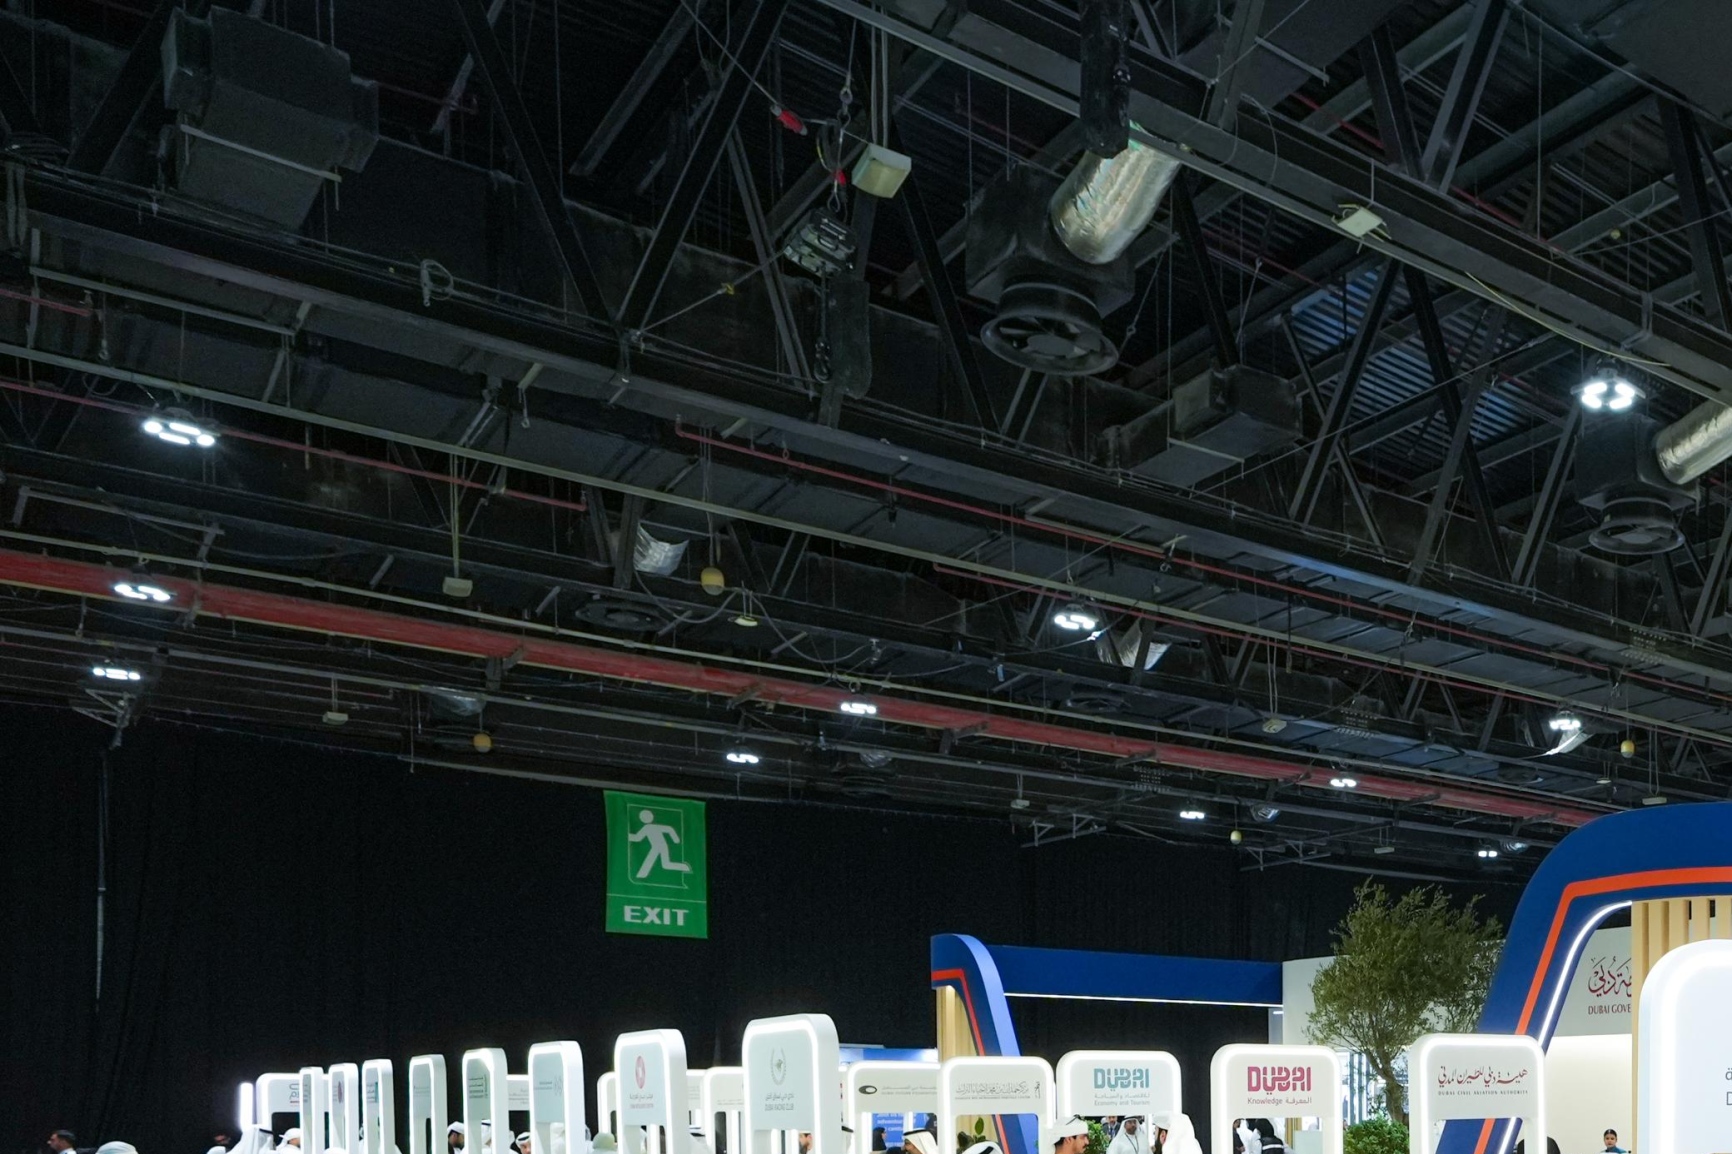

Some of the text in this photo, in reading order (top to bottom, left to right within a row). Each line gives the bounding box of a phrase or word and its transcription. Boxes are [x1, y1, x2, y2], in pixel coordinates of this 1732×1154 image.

[624, 905, 690, 926] EXIT
[1588, 1005, 1610, 1015] DUBAI
[1094, 1068, 1149, 1089] DUBAI
[1247, 1066, 1311, 1092] DUBAI
[1247, 1097, 1283, 1106] Knowledge
